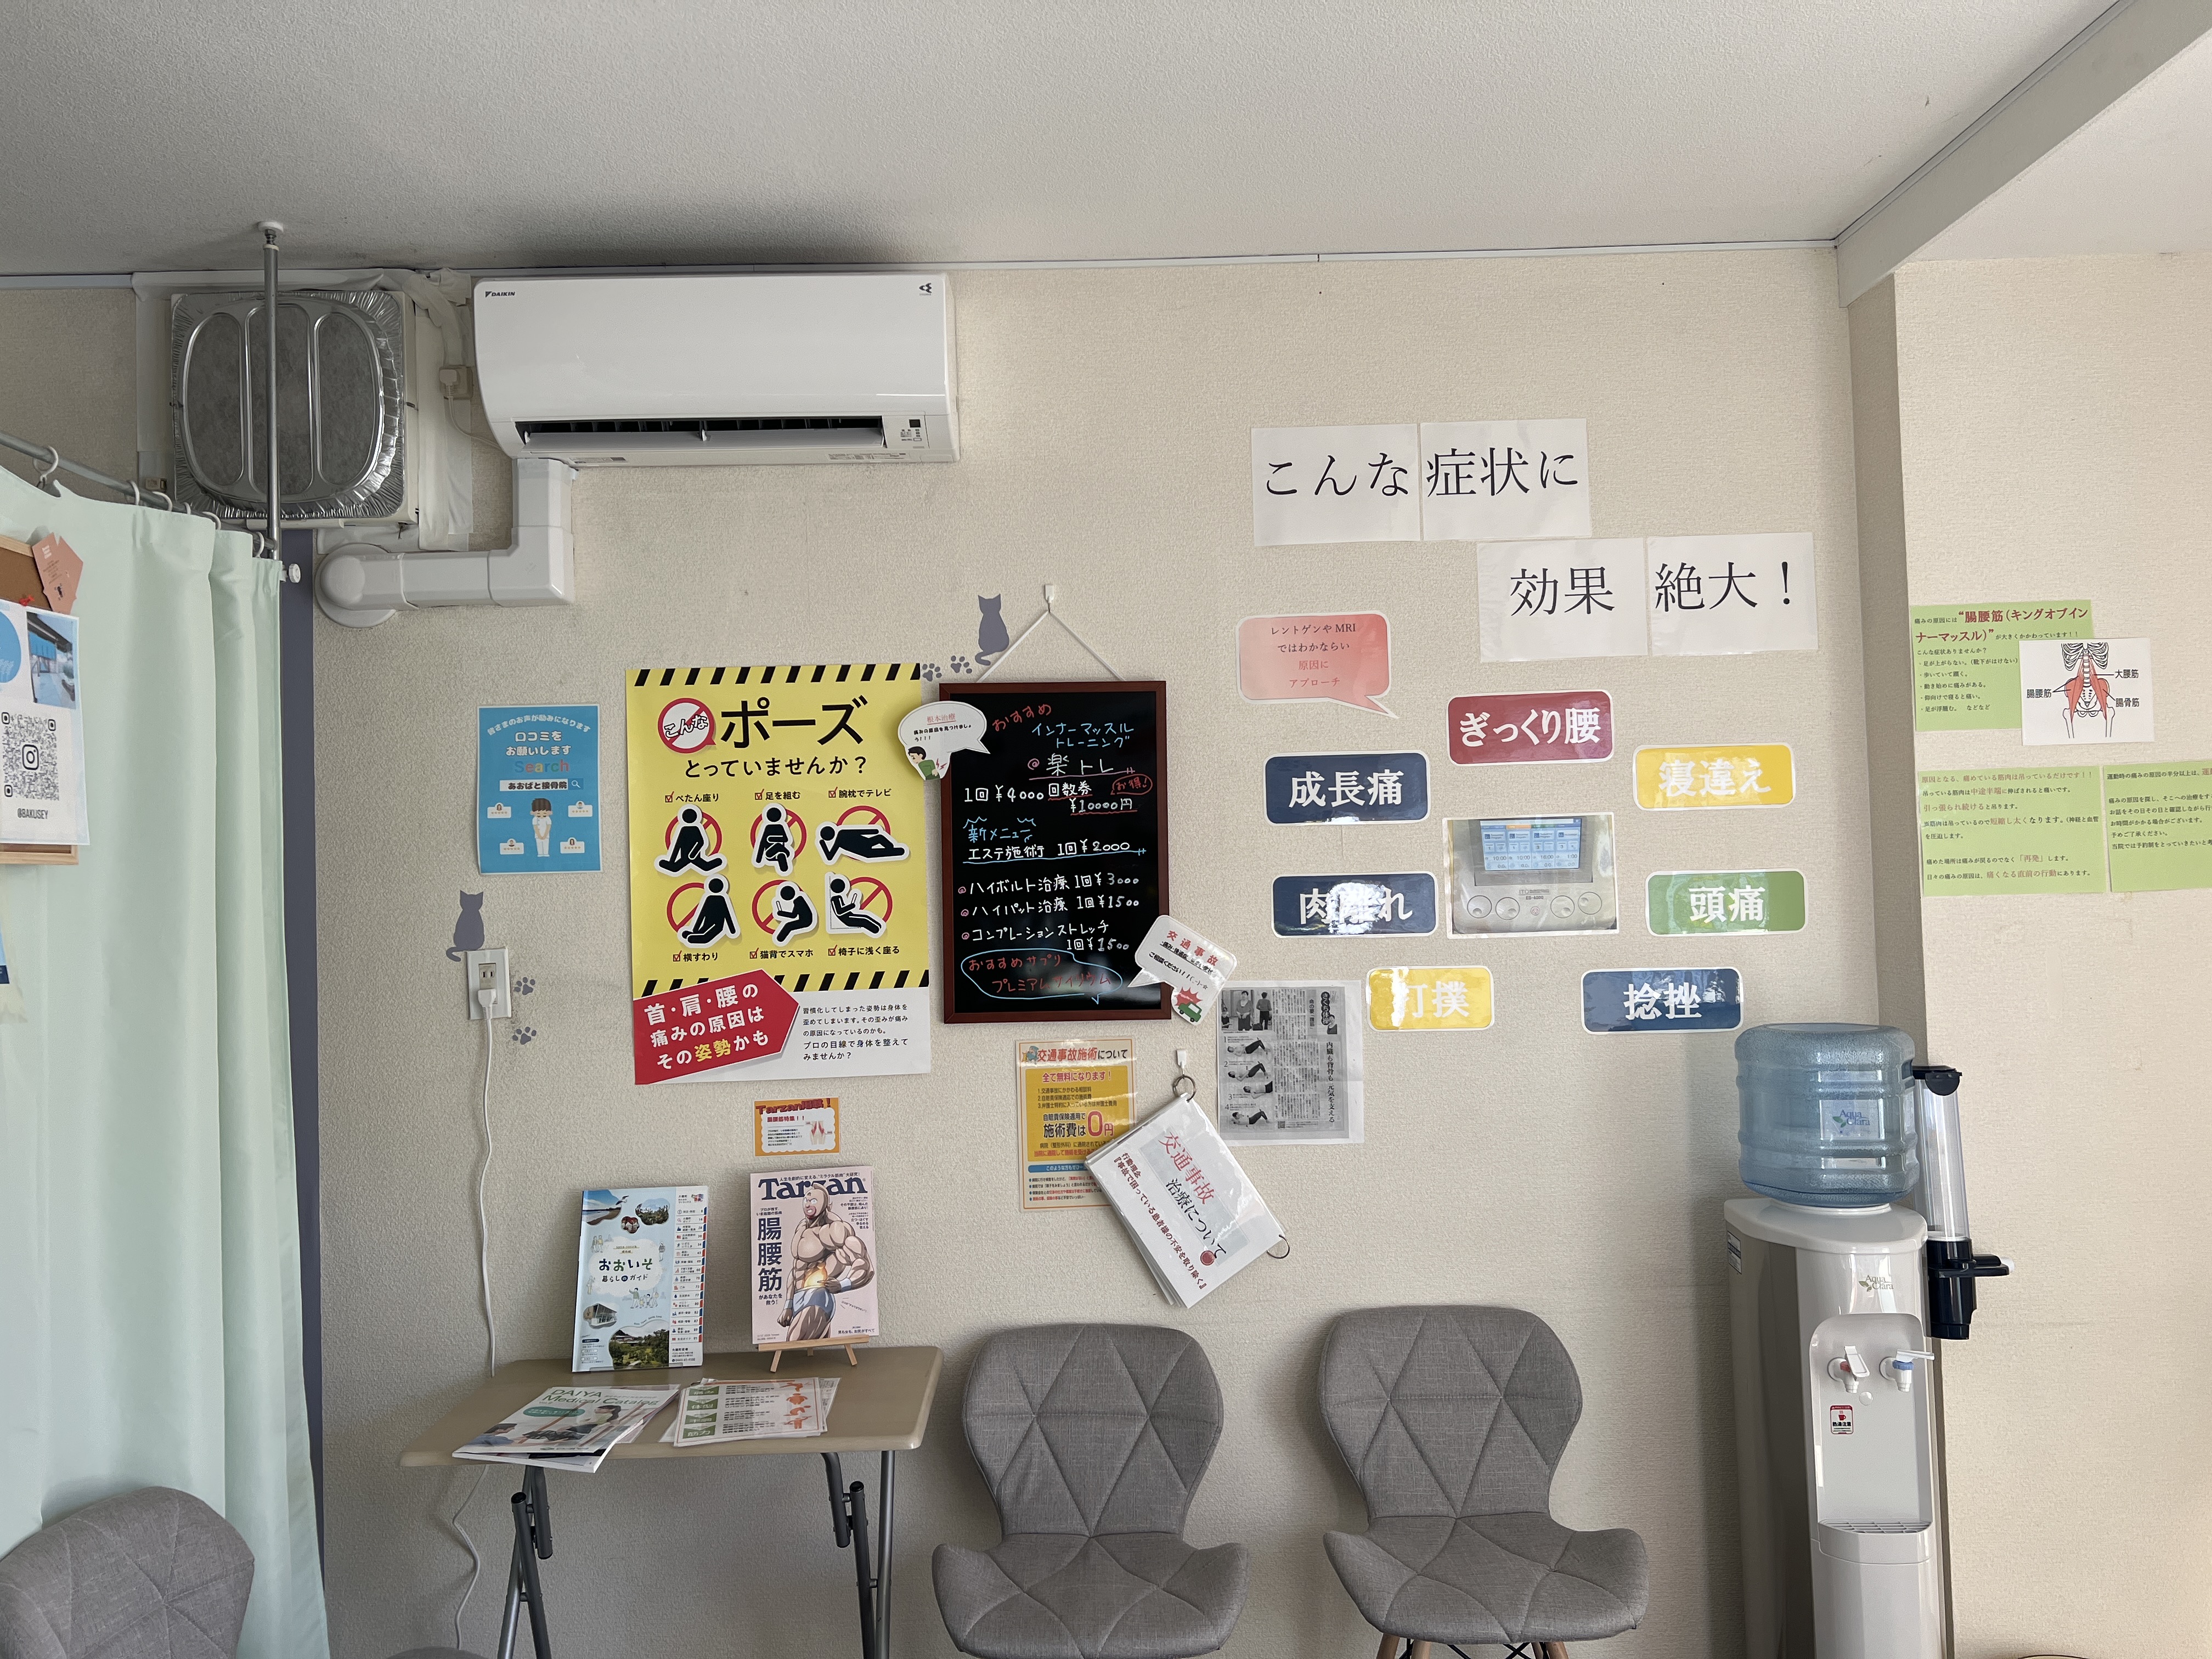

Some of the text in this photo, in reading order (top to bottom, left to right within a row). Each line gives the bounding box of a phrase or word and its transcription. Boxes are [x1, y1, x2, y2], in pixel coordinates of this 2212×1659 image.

[1266, 447, 1578, 497] こんな 症状に
[1510, 561, 1791, 617] 効果 絶大！
[1271, 623, 1356, 635] レントゲンやMRI
[1278, 641, 1350, 653] ではわかならい
[1298, 660, 1329, 670] 原因に
[2115, 669, 2138, 679] 大腰筋
[1289, 677, 1340, 688] アプローチ
[2026, 689, 2052, 698] 腸腰筋
[2115, 698, 2140, 708] 腸骨筋
[720, 695, 868, 749] ポーズ
[927, 713, 956, 723] 根本治療
[992, 703, 1052, 732] おすすめ
[663, 714, 708, 738] こんな
[1031, 722, 1135, 737] インナーマッスル
[1459, 707, 1602, 748] ぎっくり腰
[515, 730, 562, 742] 口コミを
[1056, 736, 1130, 748] トレーニング
[506, 745, 572, 757] お願いします
[514, 759, 570, 773] Search
[684, 756, 867, 778] とっていませんか？
[1658, 758, 1771, 797] 寝違え
[508, 781, 567, 790] あおばと接骨院
[1048, 780, 1092, 798] 回数券
[1289, 770, 1403, 809] 成長痛
[675, 792, 720, 803] ぺたん座り
[765, 791, 801, 800] 足を組む
[838, 788, 892, 799] 腕枕でテレビ
[2108, 793, 2212, 804] 痛みの原因を探し、そこへの治療をす
[968, 824, 1031, 843] 新メニュー
[2111, 830, 2168, 838] 予めご了承ください。
[968, 845, 1045, 860] エステ施術
[970, 873, 1070, 894] ハイボルト治療
[972, 897, 1068, 916] ハイパット治療
[1689, 884, 1766, 924] 頭痛
[838, 946, 900, 957] 椅子に浅く座る
[1166, 930, 1218, 966] 交通事故
[683, 952, 718, 962] 横すわり
[760, 949, 814, 960] 猫背でスマホ
[644, 984, 758, 1025] 首・肩・腰の
[1624, 982, 1702, 1021] 捻挫
[803, 1003, 907, 1014] 習慣化してしまった姿勢は身体を
[803, 1015, 908, 1025] 歪めてしまいます。その歪みが痛み
[650, 1006, 764, 1047] 痛みの原因は
[803, 1028, 886, 1036] の原因になっているのかも。
[657, 1030, 768, 1069] その姿勢かも
[803, 1038, 909, 1049] プロの目線で身体を整えて
[803, 1052, 851, 1061] みませんか？
[1037, 1047, 1128, 1062] 交通事故施術について
[1042, 1071, 1111, 1083] 全て無料になります！
[1839, 1109, 1863, 1119] Aqua
[1846, 1117, 1871, 1126] Clara
[1120, 1153, 1142, 1178] 行動理念
[1158, 1131, 1215, 1205] 交通事故
[1114, 1156, 1207, 1290] 『事故で困っている患者様の不安を取り除く』
[1166, 1177, 1227, 1259] 治療について
[757, 1217, 782, 1292] 腸腰筋
[599, 1258, 653, 1272] おおいそ
[602, 1273, 648, 1283] 暮らしのガイド
[1865, 1274, 1886, 1283] Aqua
[1871, 1281, 1894, 1290] Clara
[551, 1389, 602, 1397] DAIYA
[543, 1395, 600, 1403] Medical
[602, 1398, 659, 1406] Catalog
